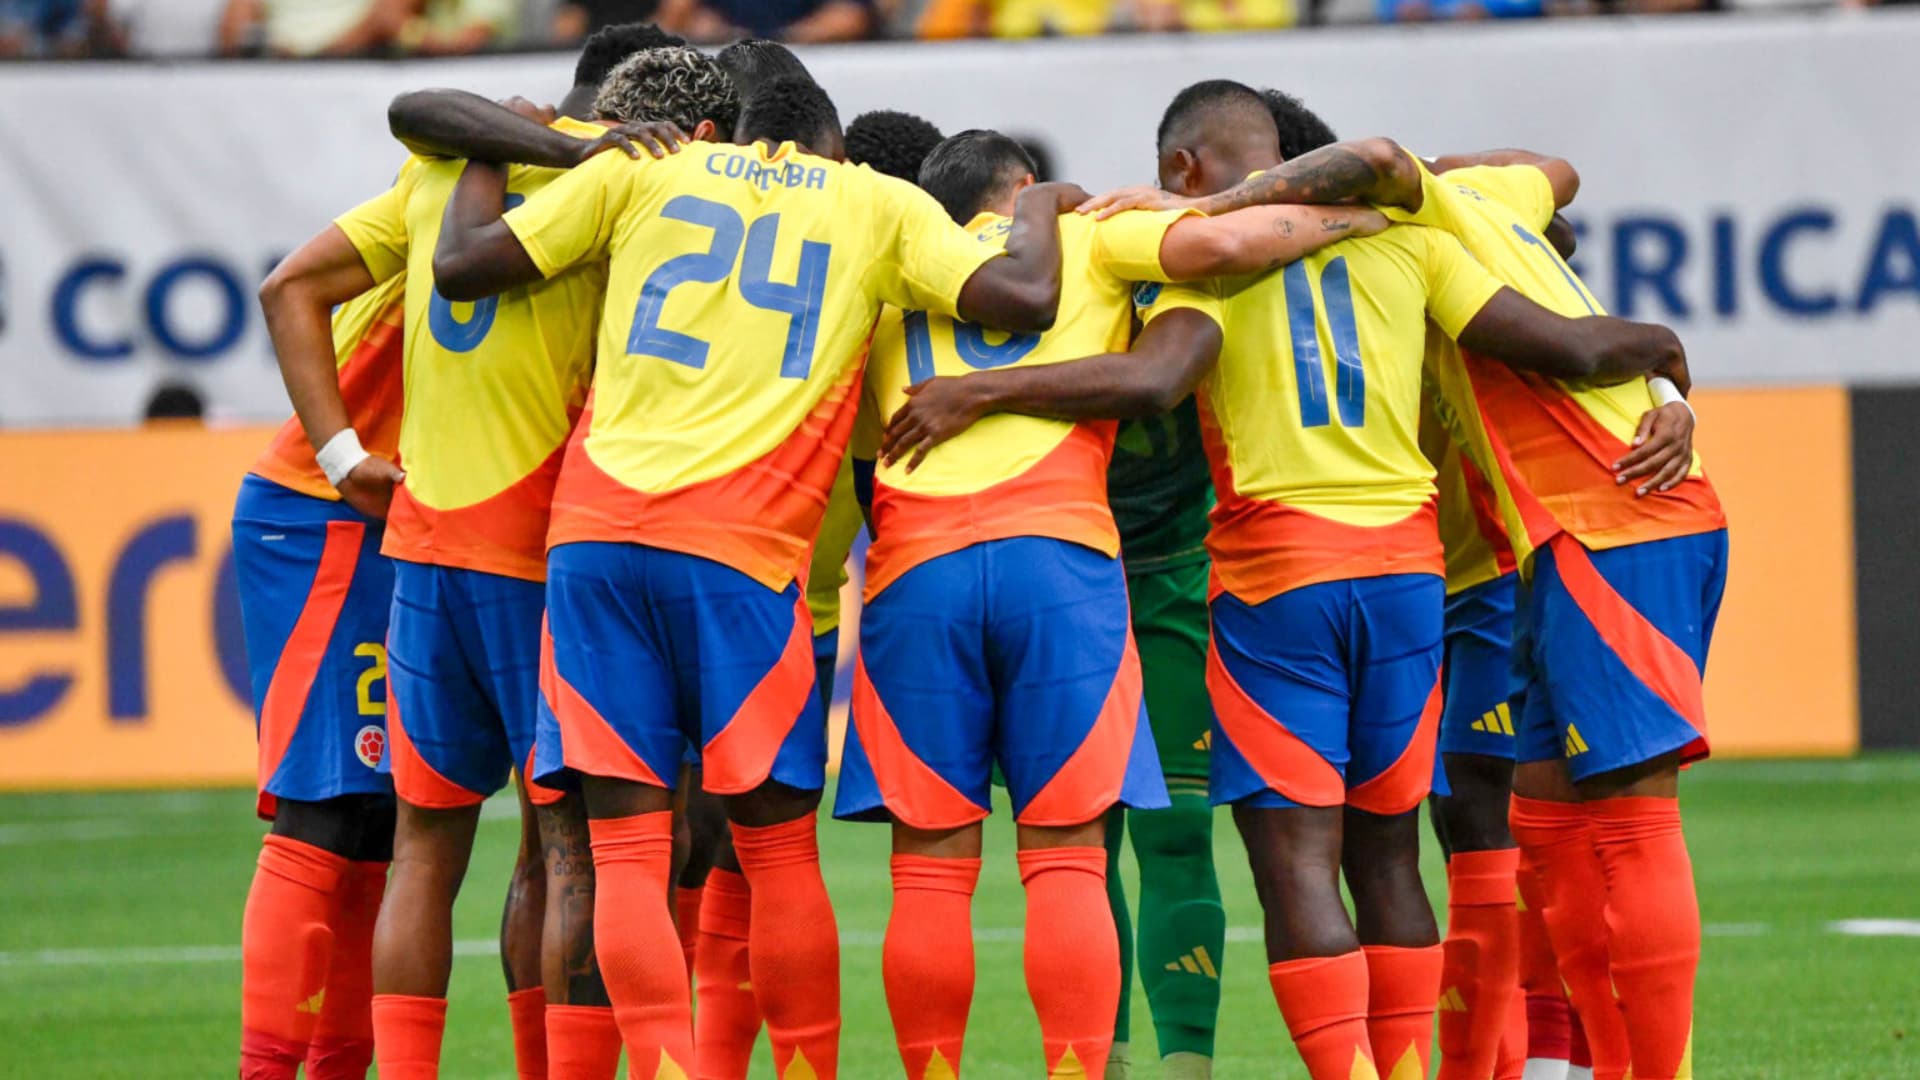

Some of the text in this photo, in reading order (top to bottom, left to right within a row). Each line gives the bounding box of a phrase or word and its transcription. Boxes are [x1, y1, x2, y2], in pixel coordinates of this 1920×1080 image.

[51, 254, 284, 361] CO
[626, 194, 832, 381] 24
[1572, 208, 1920, 320] RICA
[1283, 255, 1366, 428] 11
